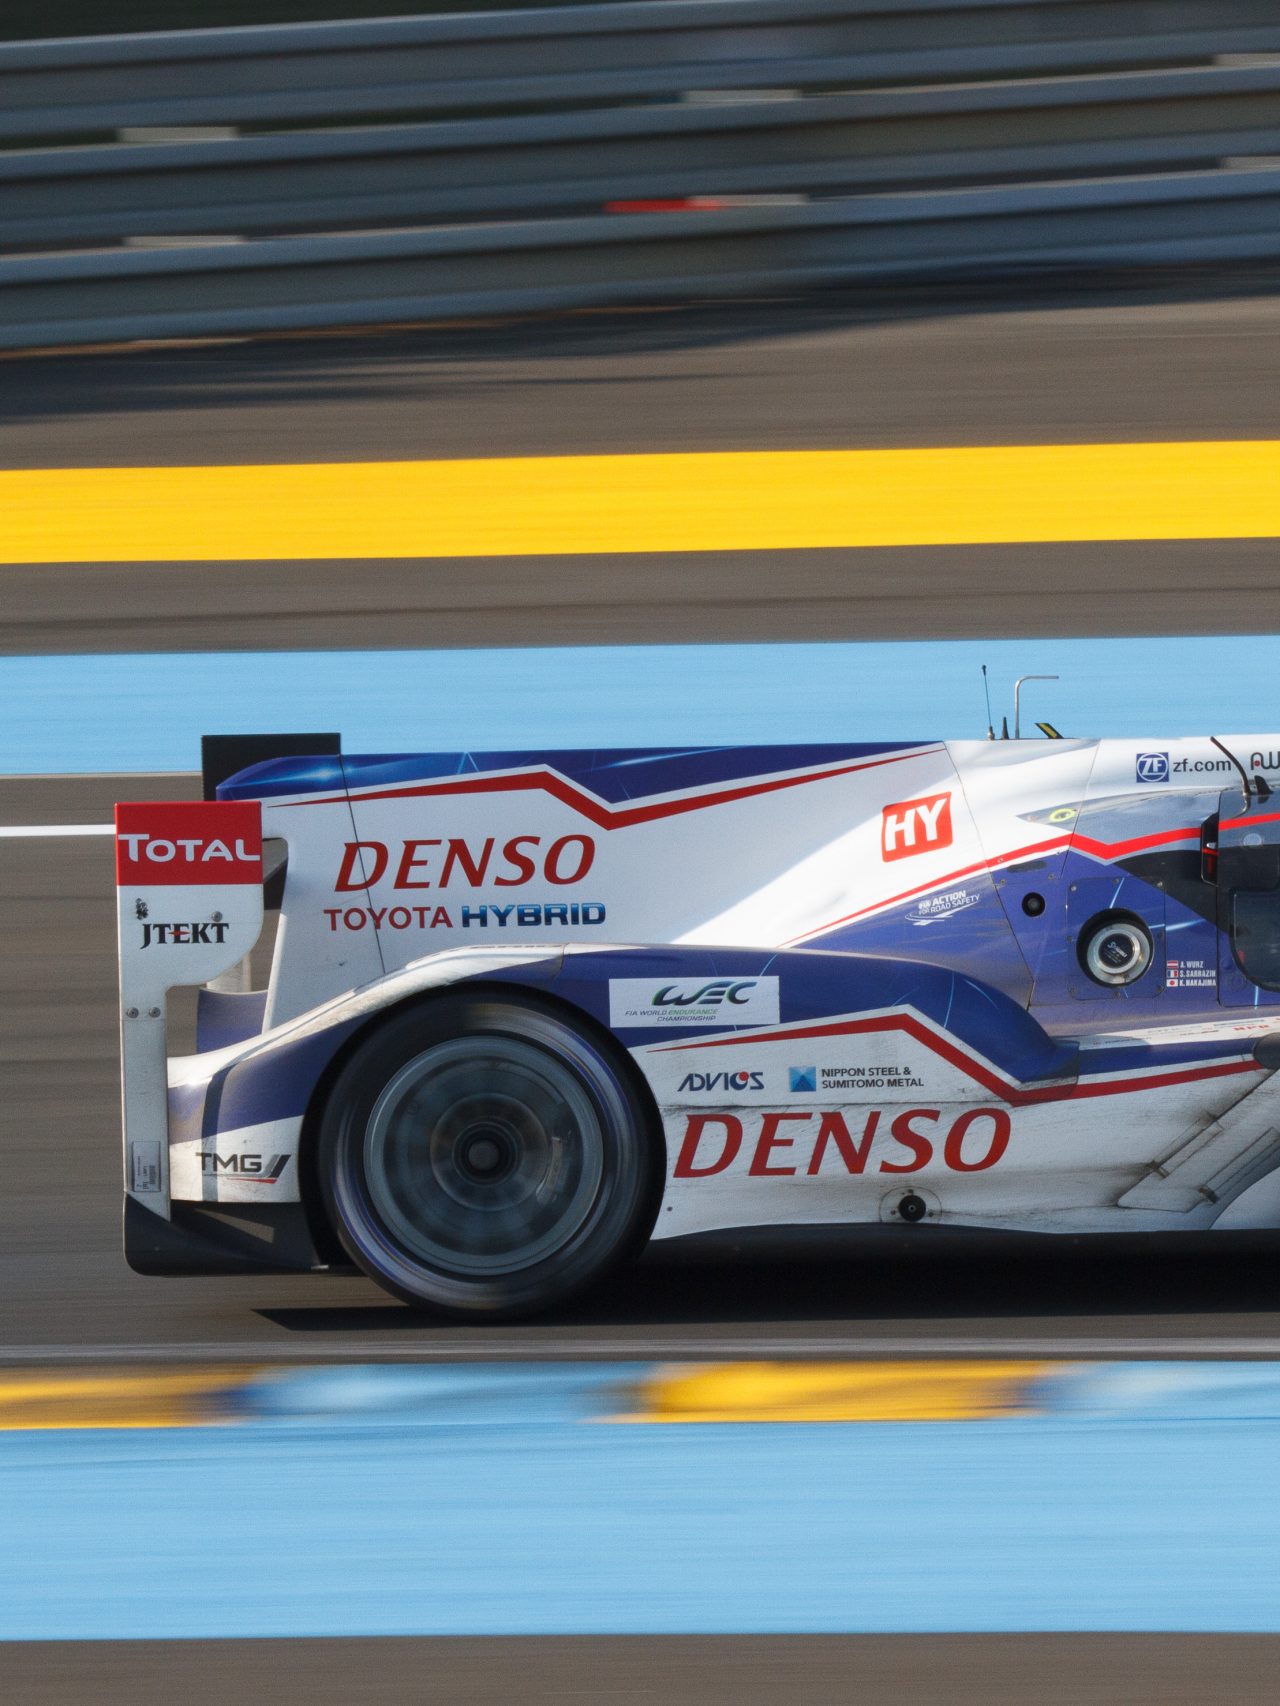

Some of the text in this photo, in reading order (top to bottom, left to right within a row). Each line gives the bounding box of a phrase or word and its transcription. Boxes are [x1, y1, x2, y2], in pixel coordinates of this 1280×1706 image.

[1139, 757, 1164, 776] ZF
[1173, 758, 1231, 773] zf.com
[884, 797, 949, 852] HY
[117, 833, 261, 863] TOTAL
[334, 834, 597, 893] DENSO
[931, 903, 951, 913] ROAD
[952, 894, 980, 908] SAFETY
[932, 890, 967, 906] ACTION
[324, 902, 607, 931] TOYOTA HYBRID
[140, 922, 230, 950] JTEKT
[652, 980, 758, 1006] WEC
[677, 1071, 765, 1092] ADVICS
[821, 1066, 911, 1077] NIPPON STEEL &
[822, 1077, 924, 1089] SUMITOMO METAL
[673, 1108, 1012, 1178] DENSO
[195, 1153, 263, 1174] TMG
